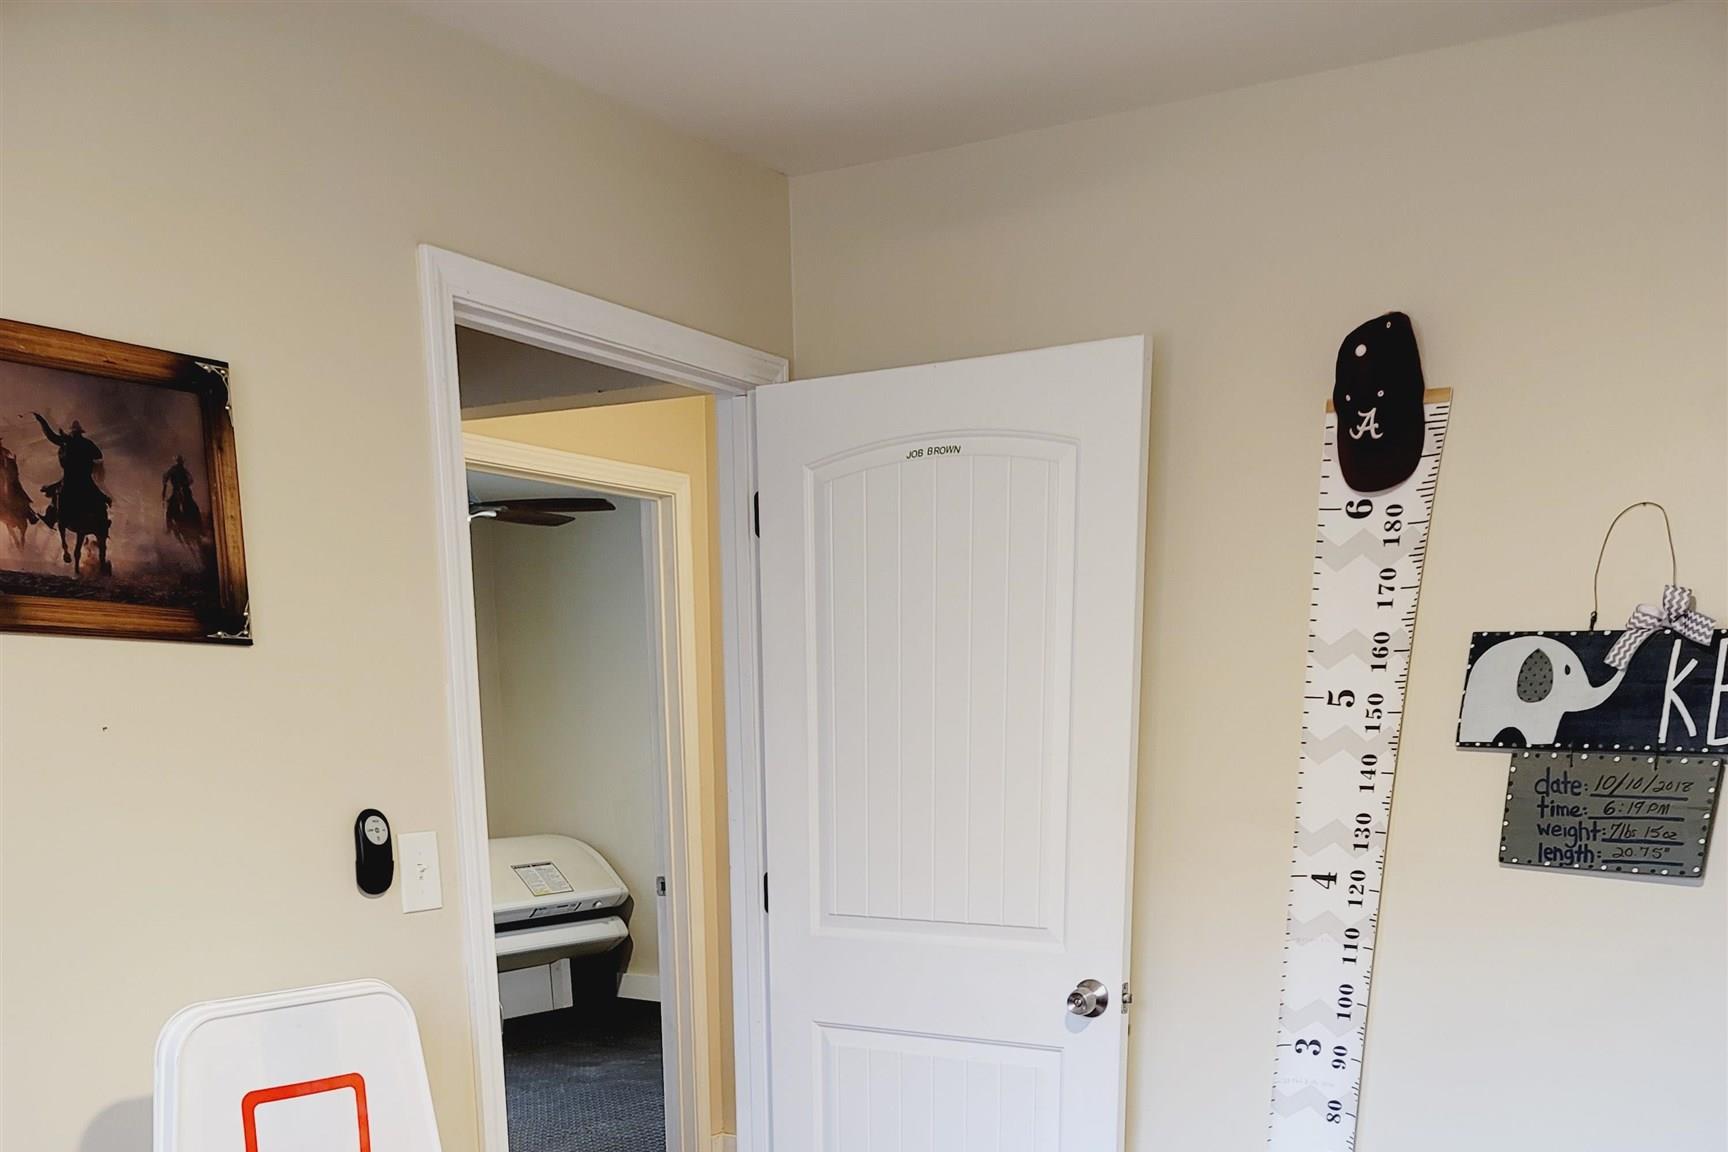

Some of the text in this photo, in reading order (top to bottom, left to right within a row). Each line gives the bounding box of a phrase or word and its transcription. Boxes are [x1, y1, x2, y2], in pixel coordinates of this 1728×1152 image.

[1350, 407, 1384, 440] A
[906, 445, 961, 459] JOB BROWN
[1345, 498, 1374, 520] 6
[1382, 503, 1405, 547] 180
[1377, 567, 1398, 610] 170
[1370, 631, 1391, 673] 160
[1327, 689, 1355, 708] 5
[1364, 692, 1385, 733] 150
[1358, 753, 1379, 793] 140
[1534, 767, 1588, 796] date:
[1537, 796, 1670, 818] time: 6:19 PM
[1353, 812, 1373, 852] 130
[1537, 821, 1606, 848] weight:
[1538, 843, 1601, 865] length:
[1311, 872, 1338, 890] 4
[1347, 868, 1367, 908] 120
[1342, 927, 1360, 965] 110
[1336, 983, 1354, 1022] 100
[1295, 1038, 1322, 1056] 3
[1331, 1045, 1349, 1069] 90
[1326, 1099, 1343, 1124] 80
